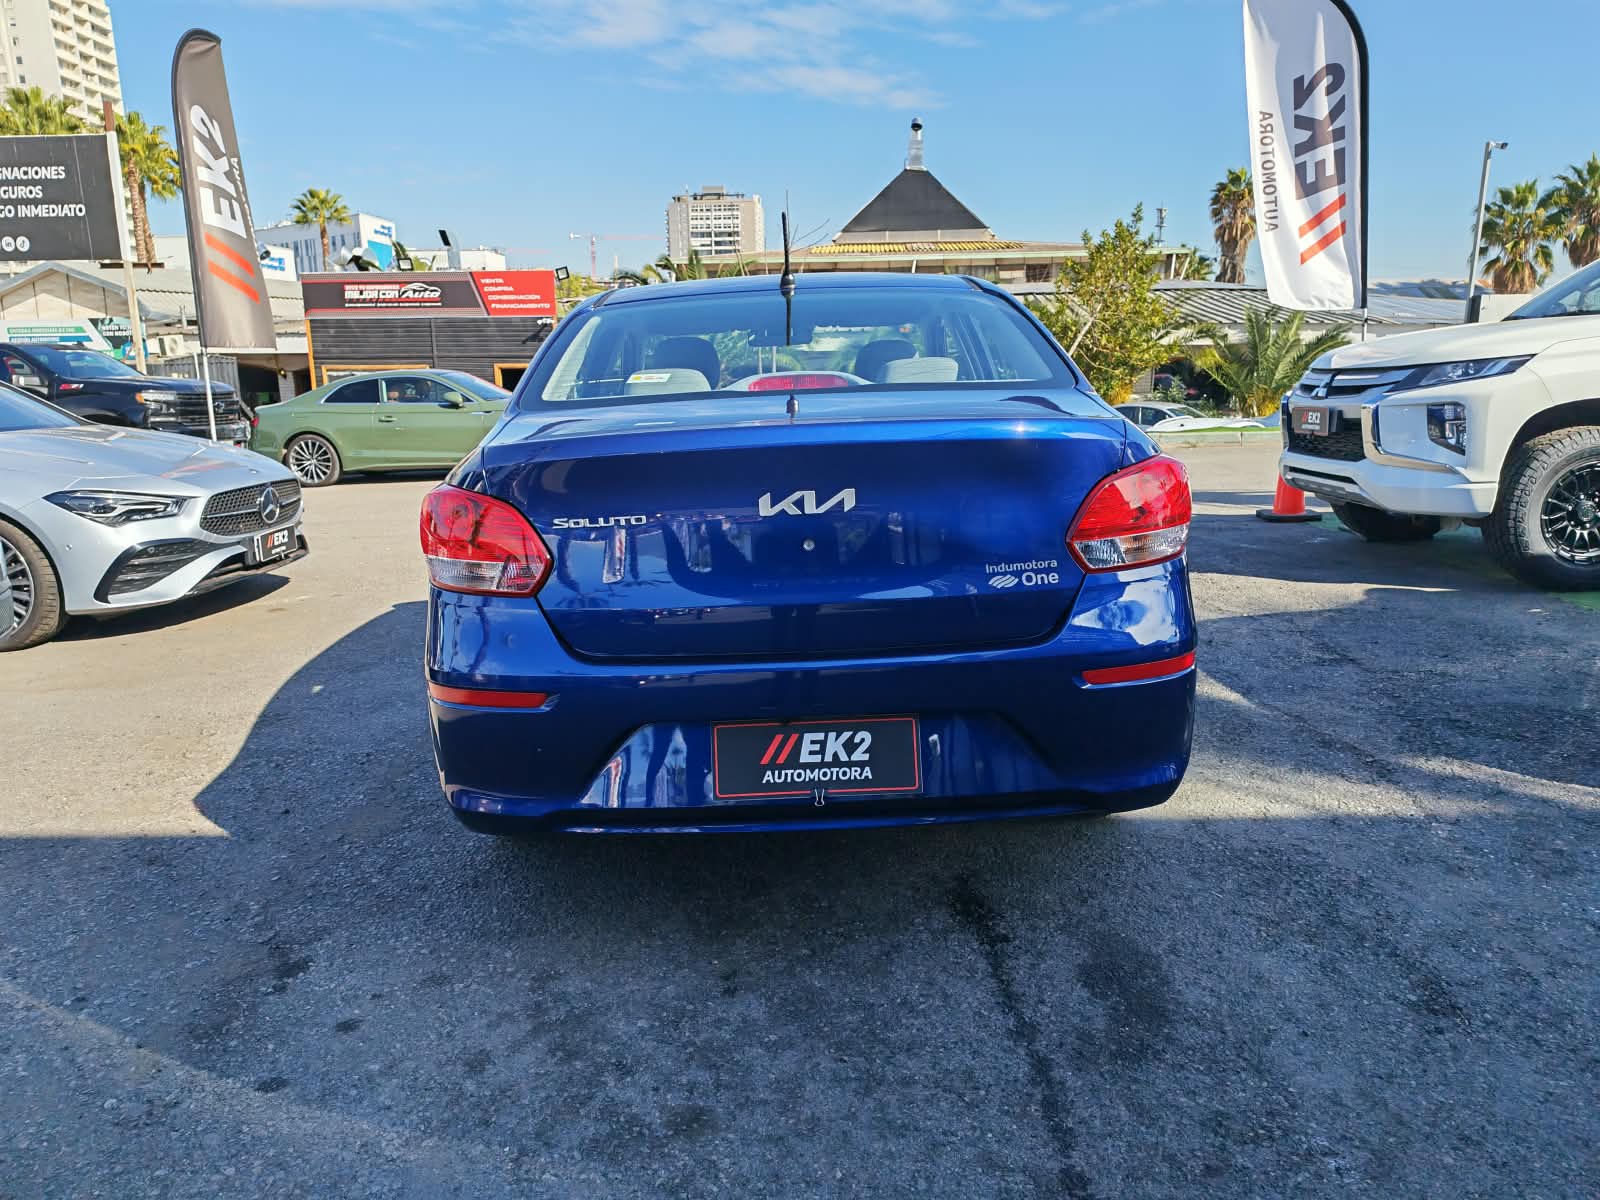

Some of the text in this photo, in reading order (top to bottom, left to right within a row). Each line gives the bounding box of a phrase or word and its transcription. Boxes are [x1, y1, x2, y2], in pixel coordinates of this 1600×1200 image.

[0, 166, 66, 180] NACIONES
[190, 105, 247, 239] EK2
[17, 204, 86, 217] INMEDIATO
[274, 530, 289, 545] EK2
[985, 560, 1058, 574] Indumotora
[1022, 571, 1060, 586] One
[799, 730, 872, 763] EK2
[762, 766, 873, 784] AUTOMOTORA
